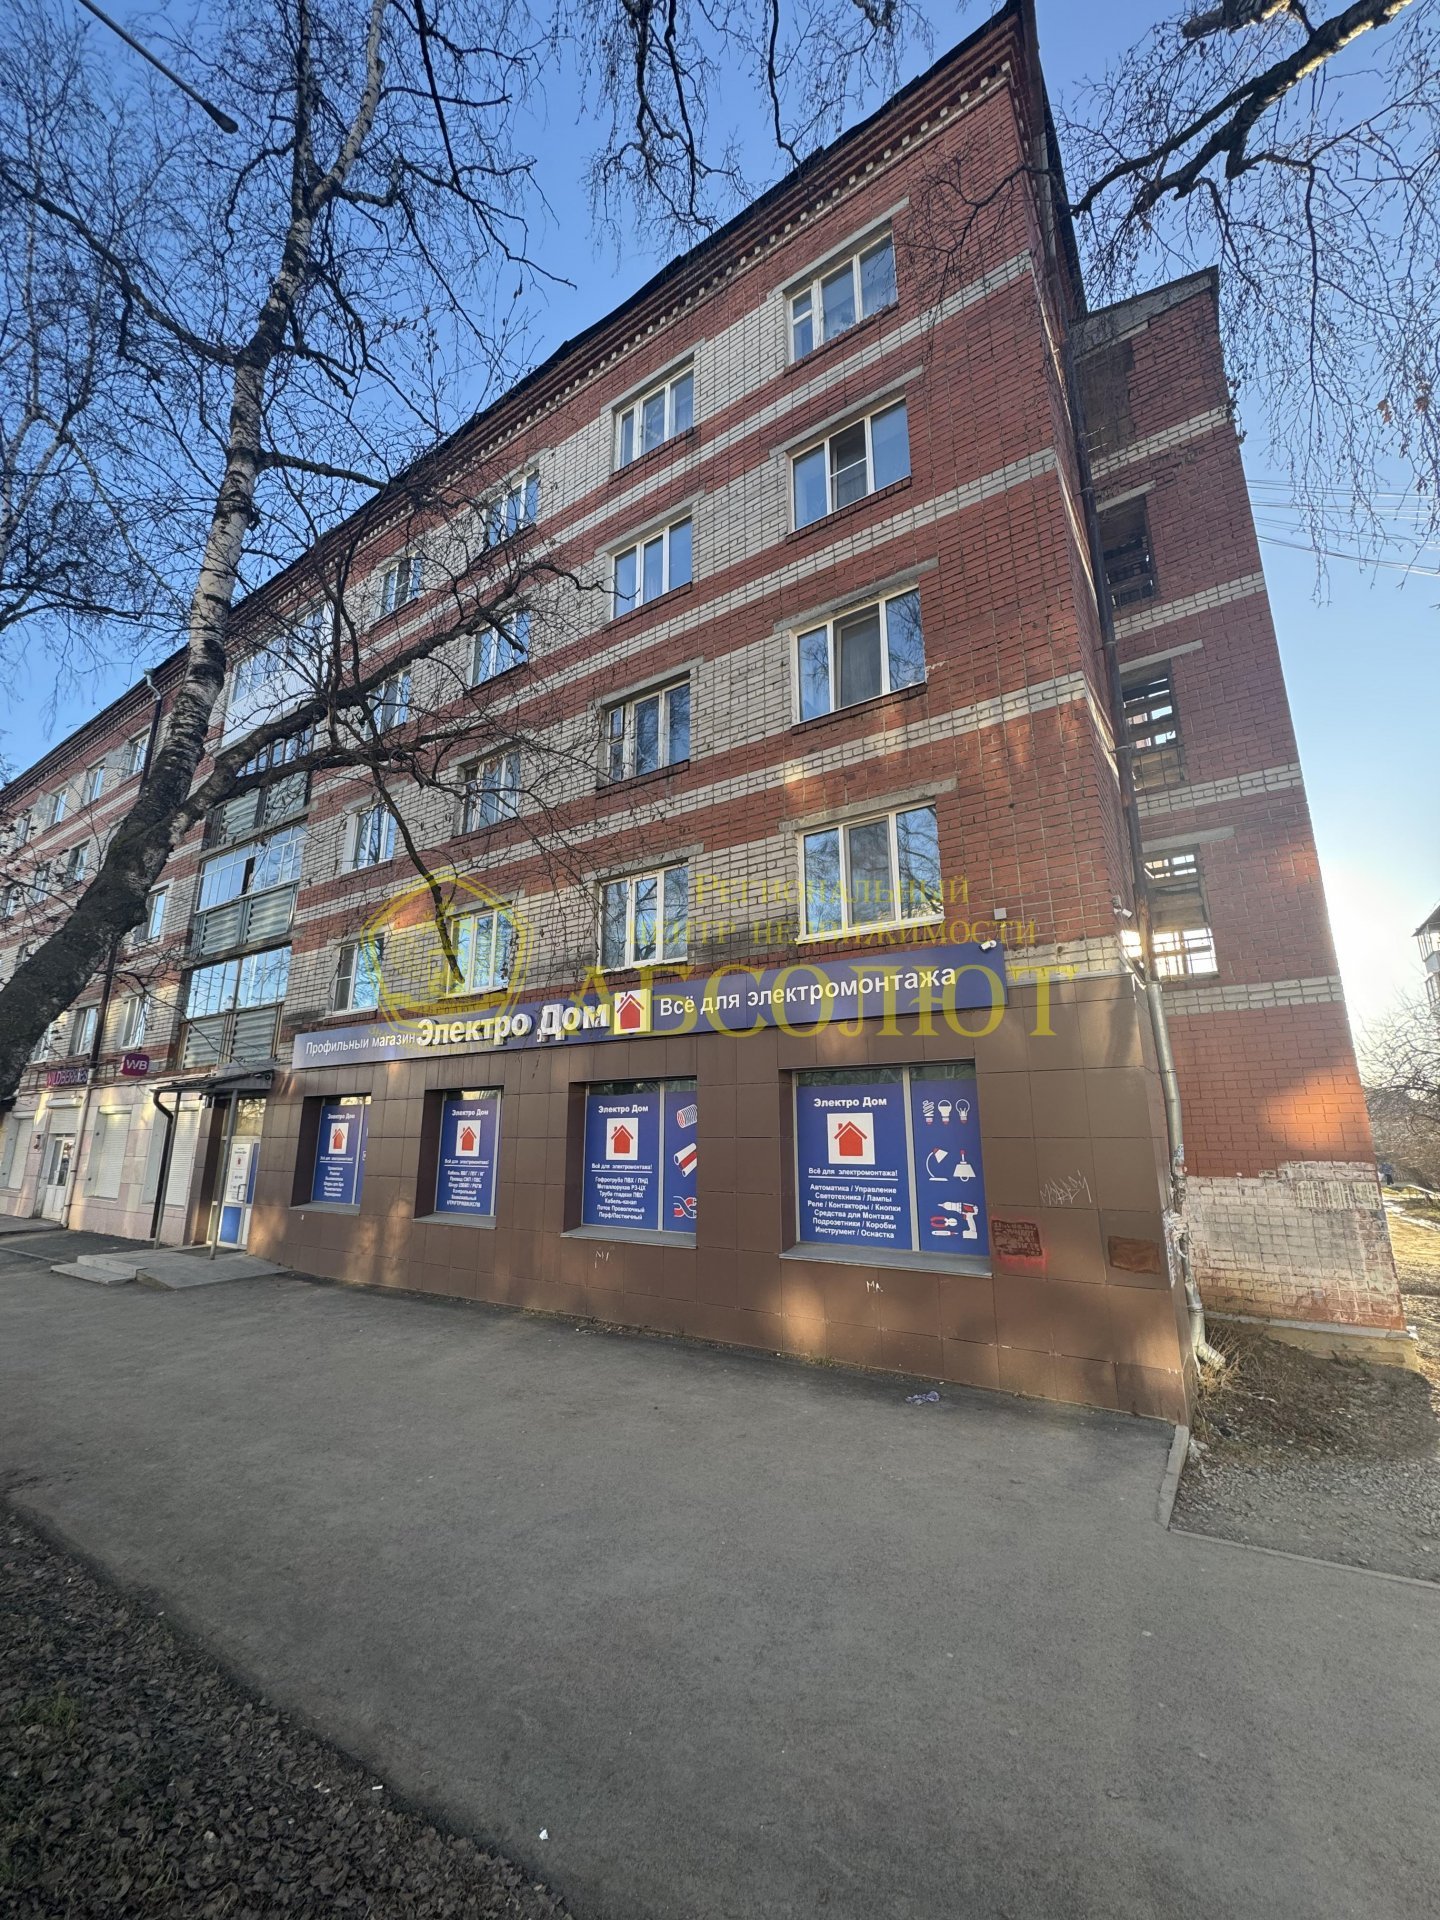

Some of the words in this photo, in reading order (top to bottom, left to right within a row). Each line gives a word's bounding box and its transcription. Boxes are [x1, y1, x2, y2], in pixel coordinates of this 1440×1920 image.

[659, 994, 695, 1016] Всё
[700, 993, 740, 1014] для
[747, 968, 956, 1007] электромонтажа
[372, 1032, 416, 1047] магазин
[416, 1013, 534, 1047] Электро
[537, 1003, 611, 1043] Дом
[126, 1059, 148, 1070] WB
[814, 1098, 859, 1109] Электро
[862, 1096, 887, 1108] Дом
[452, 1109, 475, 1118] Электро
[476, 1108, 489, 1117] Дом
[598, 1104, 630, 1114] Электро
[632, 1104, 649, 1113] Дом
[808, 1167, 821, 1175] Всё
[821, 1168, 835, 1176] для
[838, 1168, 898, 1177] электромонтажа!
[809, 1183, 849, 1192] Автоматика
[854, 1184, 897, 1194] Управление
[815, 1192, 861, 1201] Светотехника
[866, 1194, 892, 1203] Лампы
[807, 1200, 824, 1208] Реле
[828, 1201, 870, 1212] Контакторы
[875, 1204, 902, 1212] Кнопки
[814, 1209, 847, 1219] Средства
[847, 1211, 861, 1219] для
[862, 1211, 895, 1221] Монтажа
[812, 1217, 861, 1228] Подрозетники
[866, 1220, 897, 1230] Коробки
[815, 1226, 856, 1237] Инструмент
[860, 1229, 895, 1239] Оснастка
